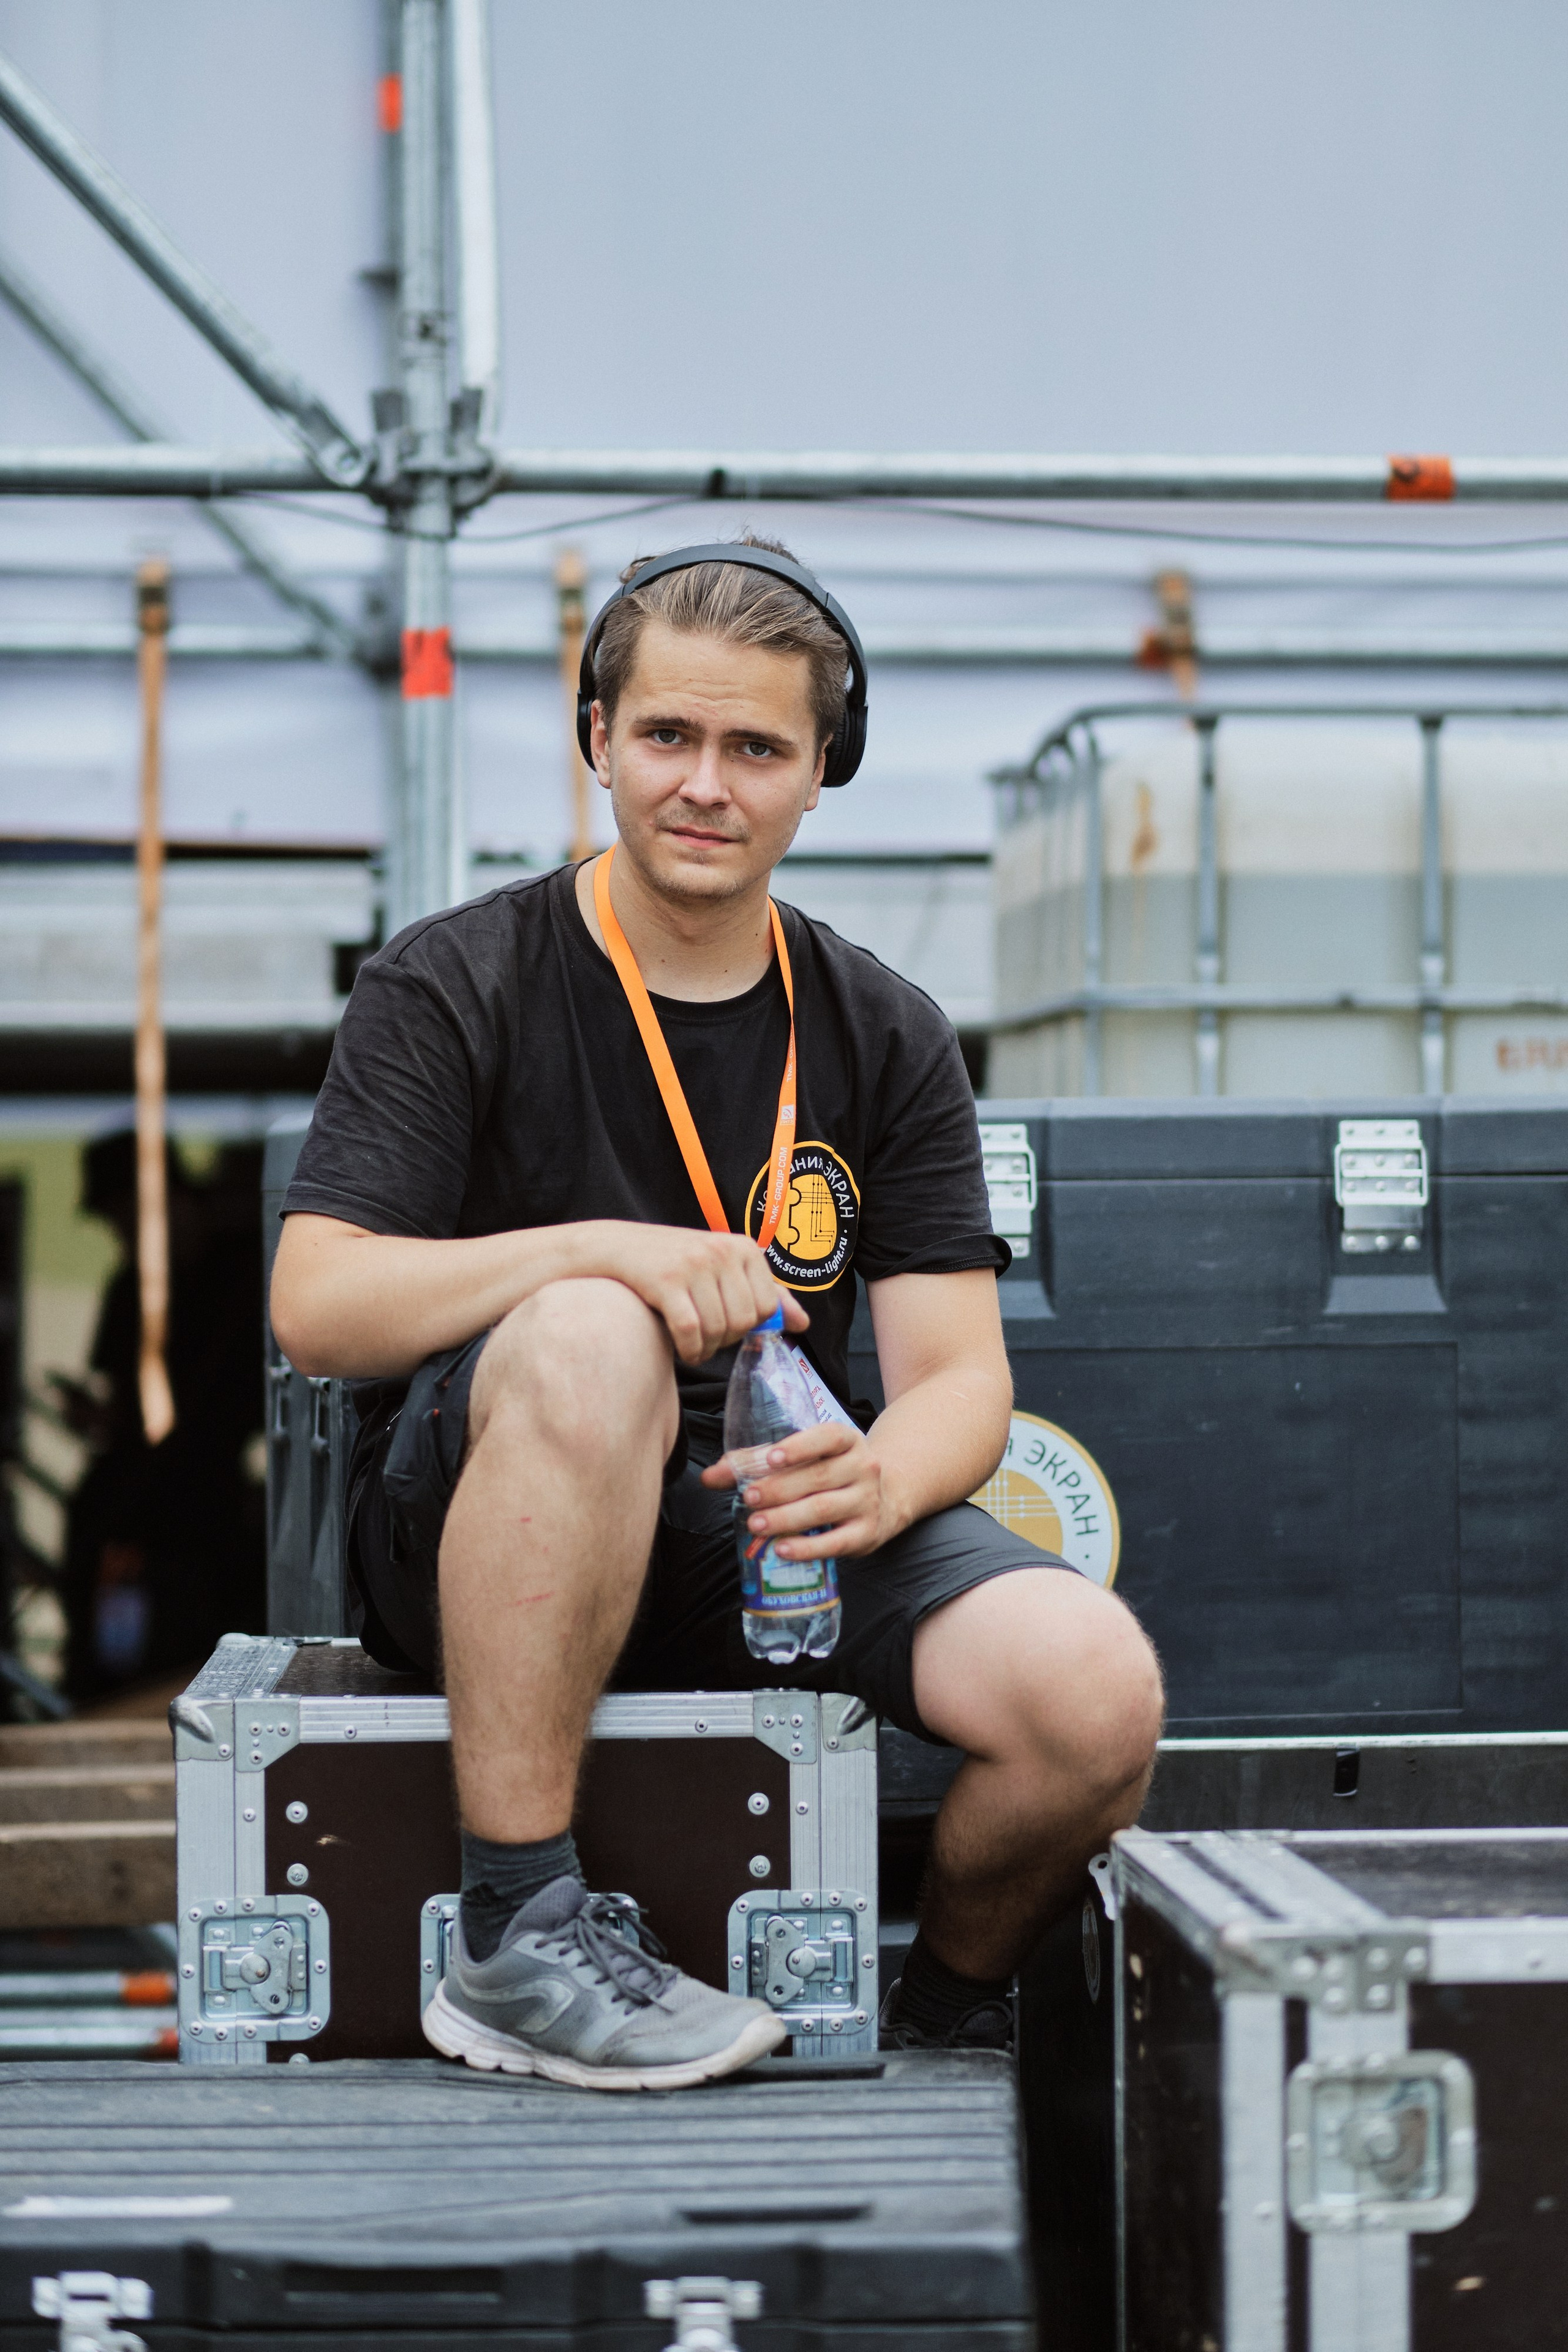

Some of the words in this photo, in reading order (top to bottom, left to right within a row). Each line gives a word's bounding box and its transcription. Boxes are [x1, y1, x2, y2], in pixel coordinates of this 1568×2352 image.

[769, 1147, 788, 1224] TMK-GROUP.COM
[823, 1161, 855, 1218] ЭКРАН
[766, 1237, 848, 1278] ww.screen-light.ru
[1023, 1439, 1099, 1536] ЭКРАН
